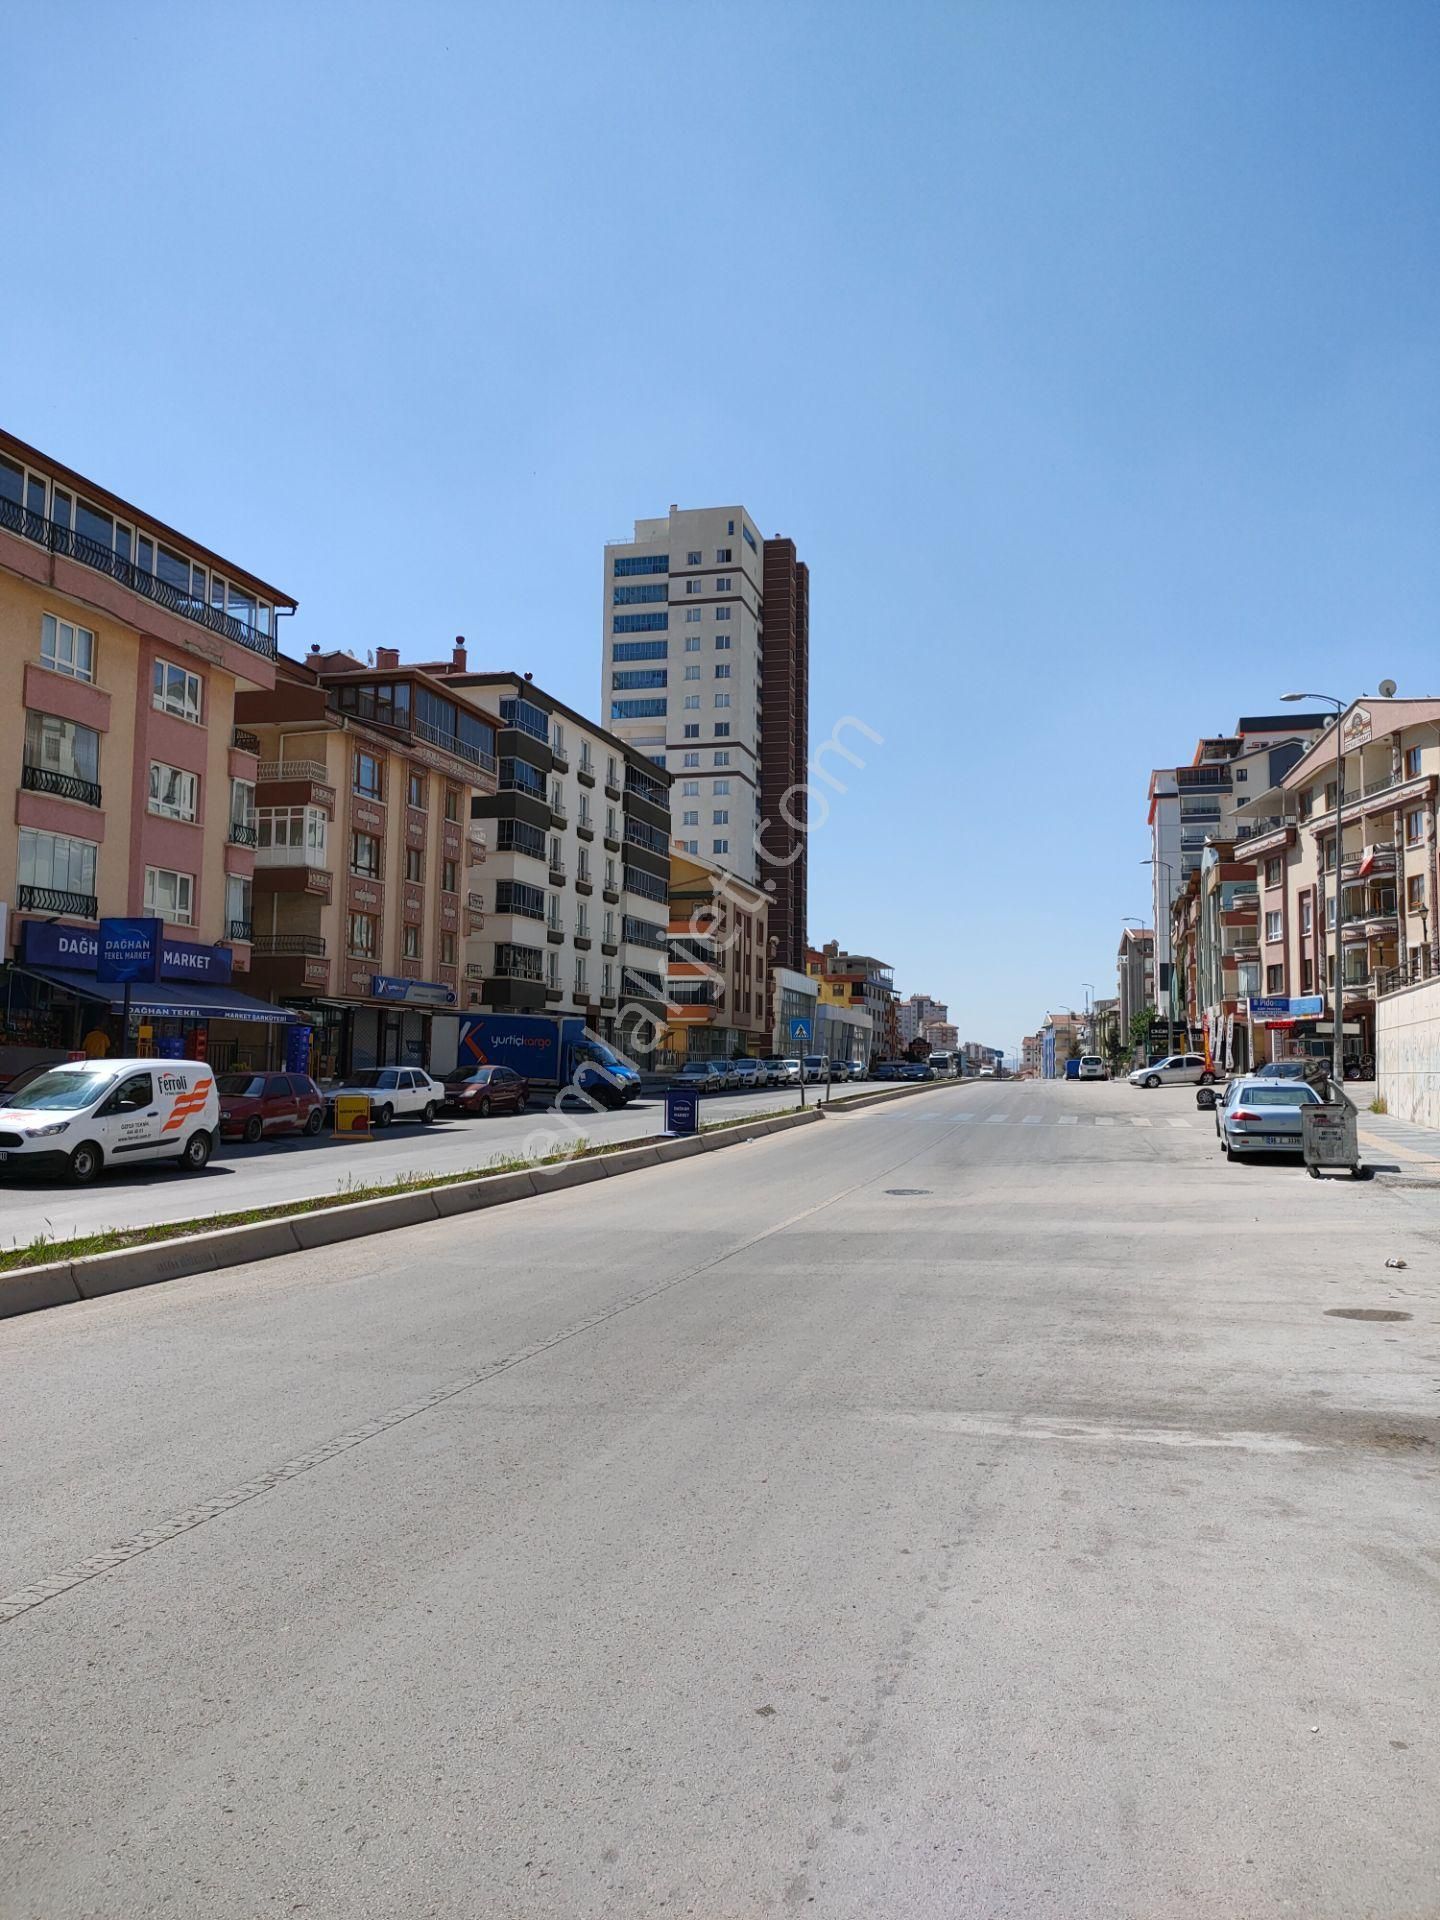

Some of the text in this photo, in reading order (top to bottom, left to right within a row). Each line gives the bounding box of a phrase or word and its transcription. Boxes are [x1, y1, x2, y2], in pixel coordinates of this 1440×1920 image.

[105, 939, 150, 950] DAĞHAN
[104, 951, 151, 960] TEKEL MARKET
[163, 951, 211, 970] MARKET
[171, 1009, 201, 1018] TEKEL
[224, 1012, 251, 1020] MARKET
[157, 1075, 188, 1095] Ferroli
